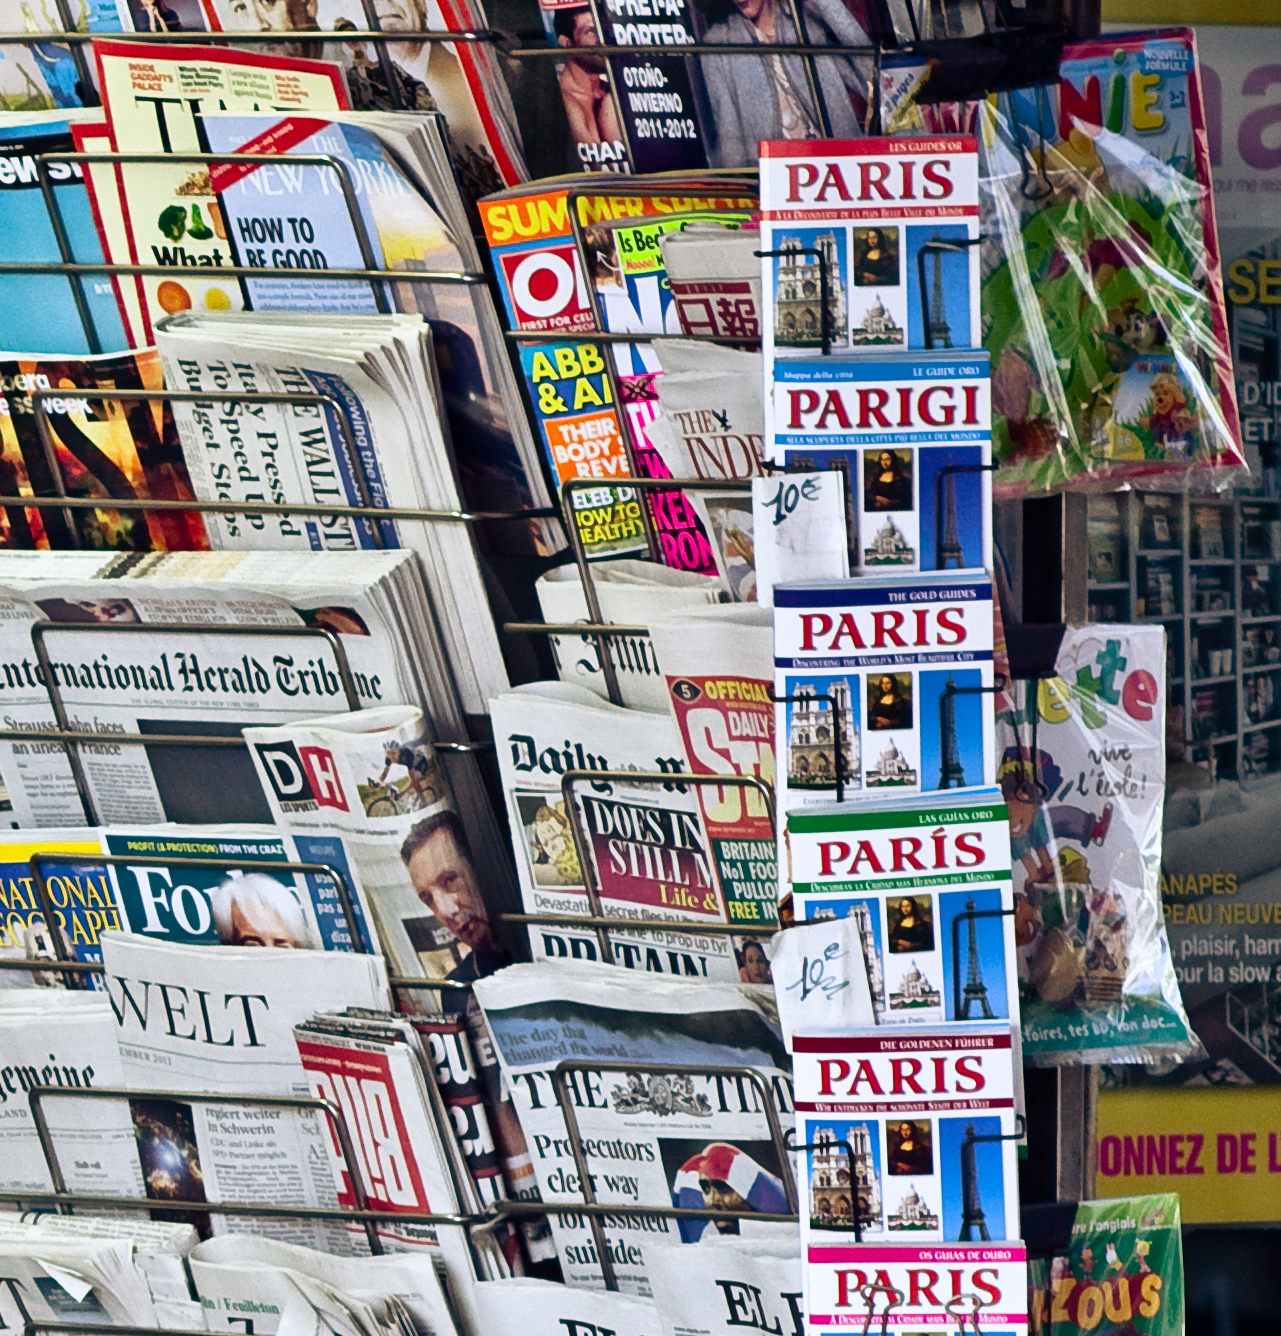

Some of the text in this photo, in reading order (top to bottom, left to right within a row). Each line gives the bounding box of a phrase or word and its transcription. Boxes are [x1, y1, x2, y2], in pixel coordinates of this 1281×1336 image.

[1144, 48, 1190, 62] NOUVELLE
[128, 63, 155, 74] INSIDE
[623, 61, 668, 90] OTOÑO-
[132, 81, 164, 93] PALACE
[629, 90, 683, 115] INVIERNO
[634, 116, 698, 141] 2011-2012
[889, 141, 948, 153] LES GUIDES
[785, 159, 953, 203] PARIS
[238, 217, 314, 244] HOW TO
[913, 366, 980, 377] LE GUIDE ORO
[787, 385, 980, 430] PARIGI
[554, 441, 616, 465] BODY
[888, 588, 978, 602] THE GOLD GUIDES
[798, 606, 969, 652] PARIS
[173, 651, 271, 695] Herald
[507, 732, 609, 797] Daily
[593, 800, 675, 847] DOES
[918, 810, 993, 824] LAS ORO
[218, 843, 241, 854] FROM
[608, 839, 692, 882] STILL
[816, 827, 987, 877] PARÍS
[659, 884, 696, 908] Life
[727, 900, 760, 920] FREE
[1181, 935, 1238, 959] plaisir,
[1228, 962, 1269, 984] slow
[109, 975, 271, 1048] WELT
[594, 1042, 629, 1059] world
[879, 1037, 994, 1050] DIE GOLDENEN FÜHRER
[816, 1055, 987, 1095] PARIS
[220, 1120, 276, 1137] Schwerin
[1216, 1135, 1256, 1174] DE
[836, 1268, 1004, 1308] PARIS
